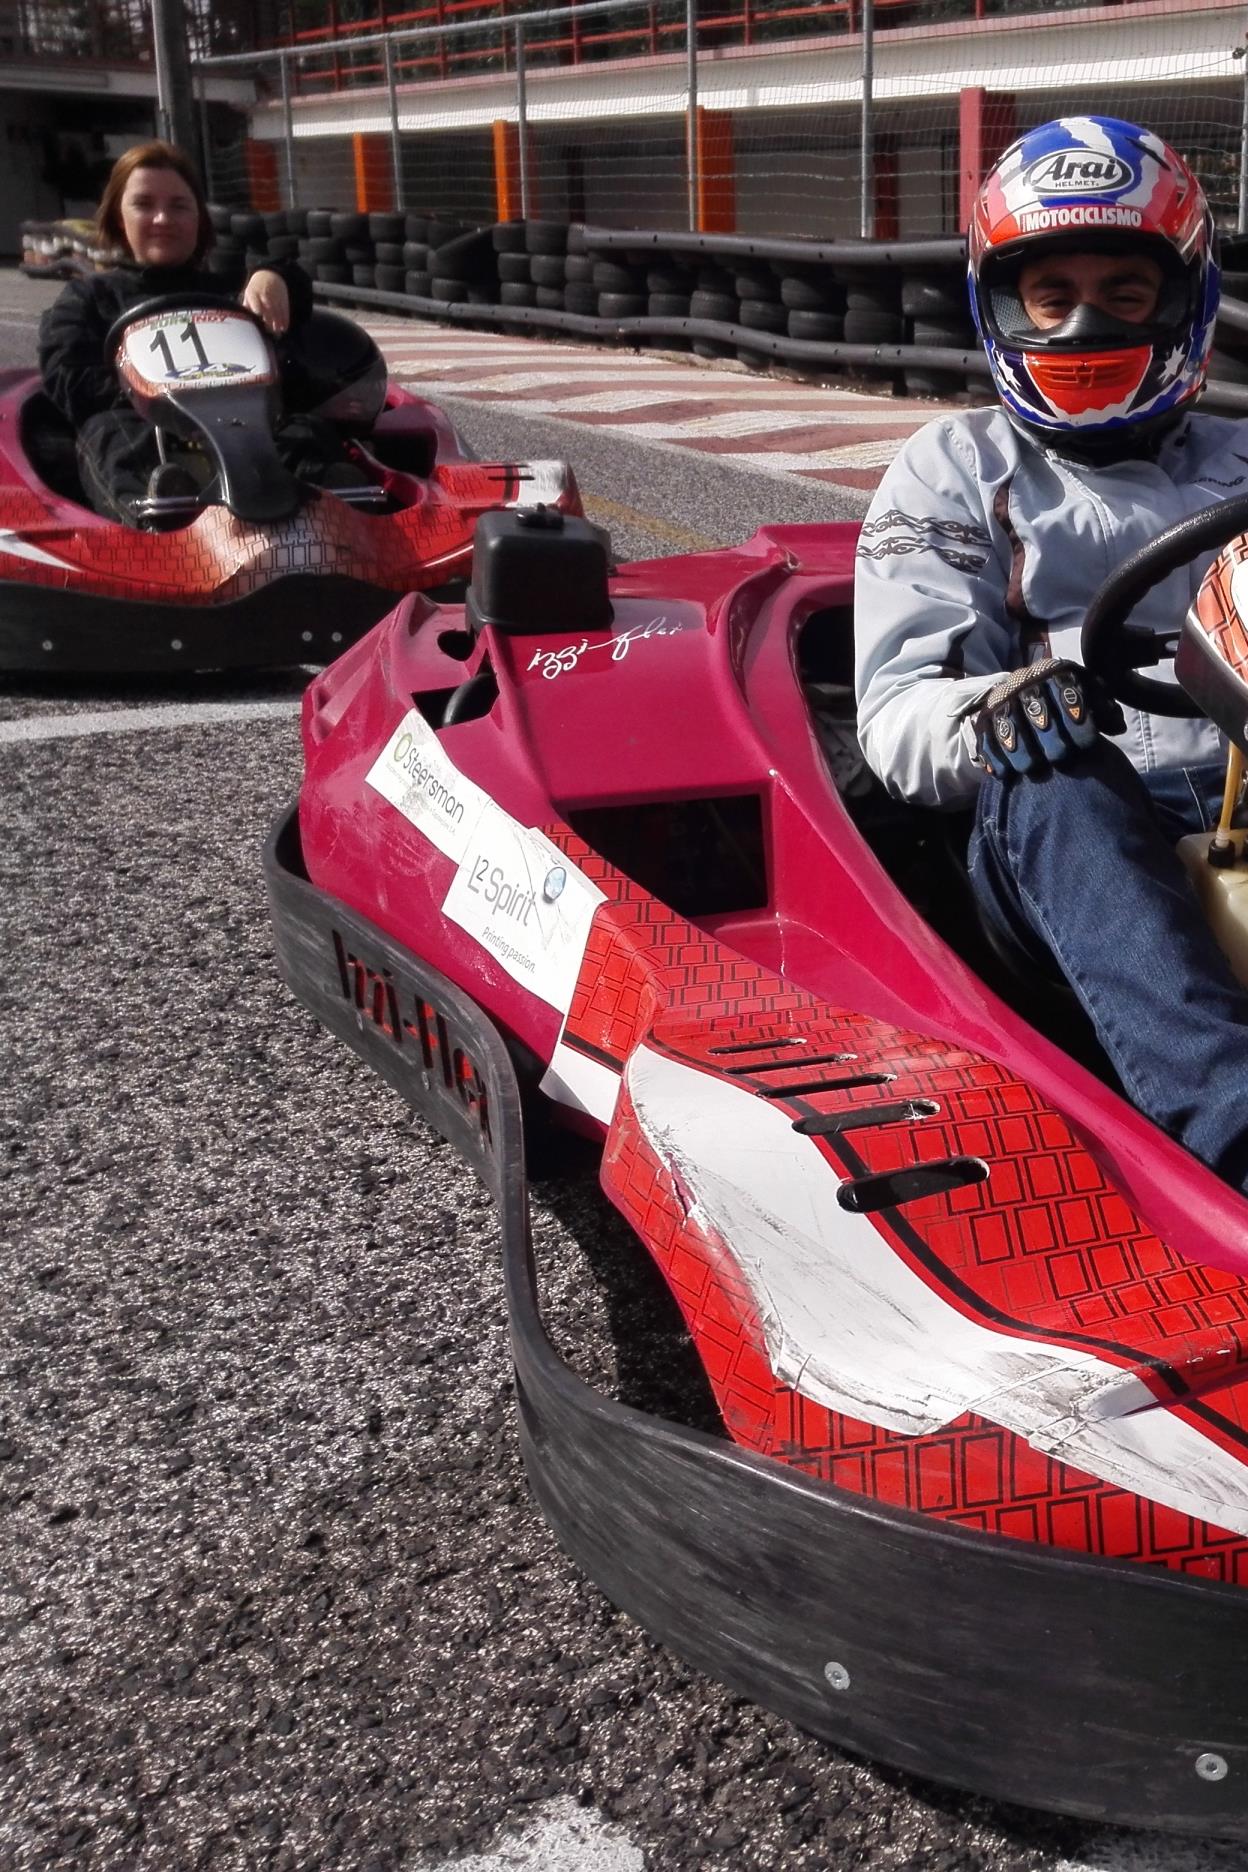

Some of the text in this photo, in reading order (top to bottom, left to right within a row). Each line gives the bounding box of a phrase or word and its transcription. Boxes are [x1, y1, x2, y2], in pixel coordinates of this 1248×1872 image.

[1032, 154, 1118, 185] Arai
[1025, 207, 1142, 230] MOTOCICLISMO
[150, 321, 209, 373] 11
[403, 746, 465, 824] Steersman
[481, 926, 510, 957] Printing
